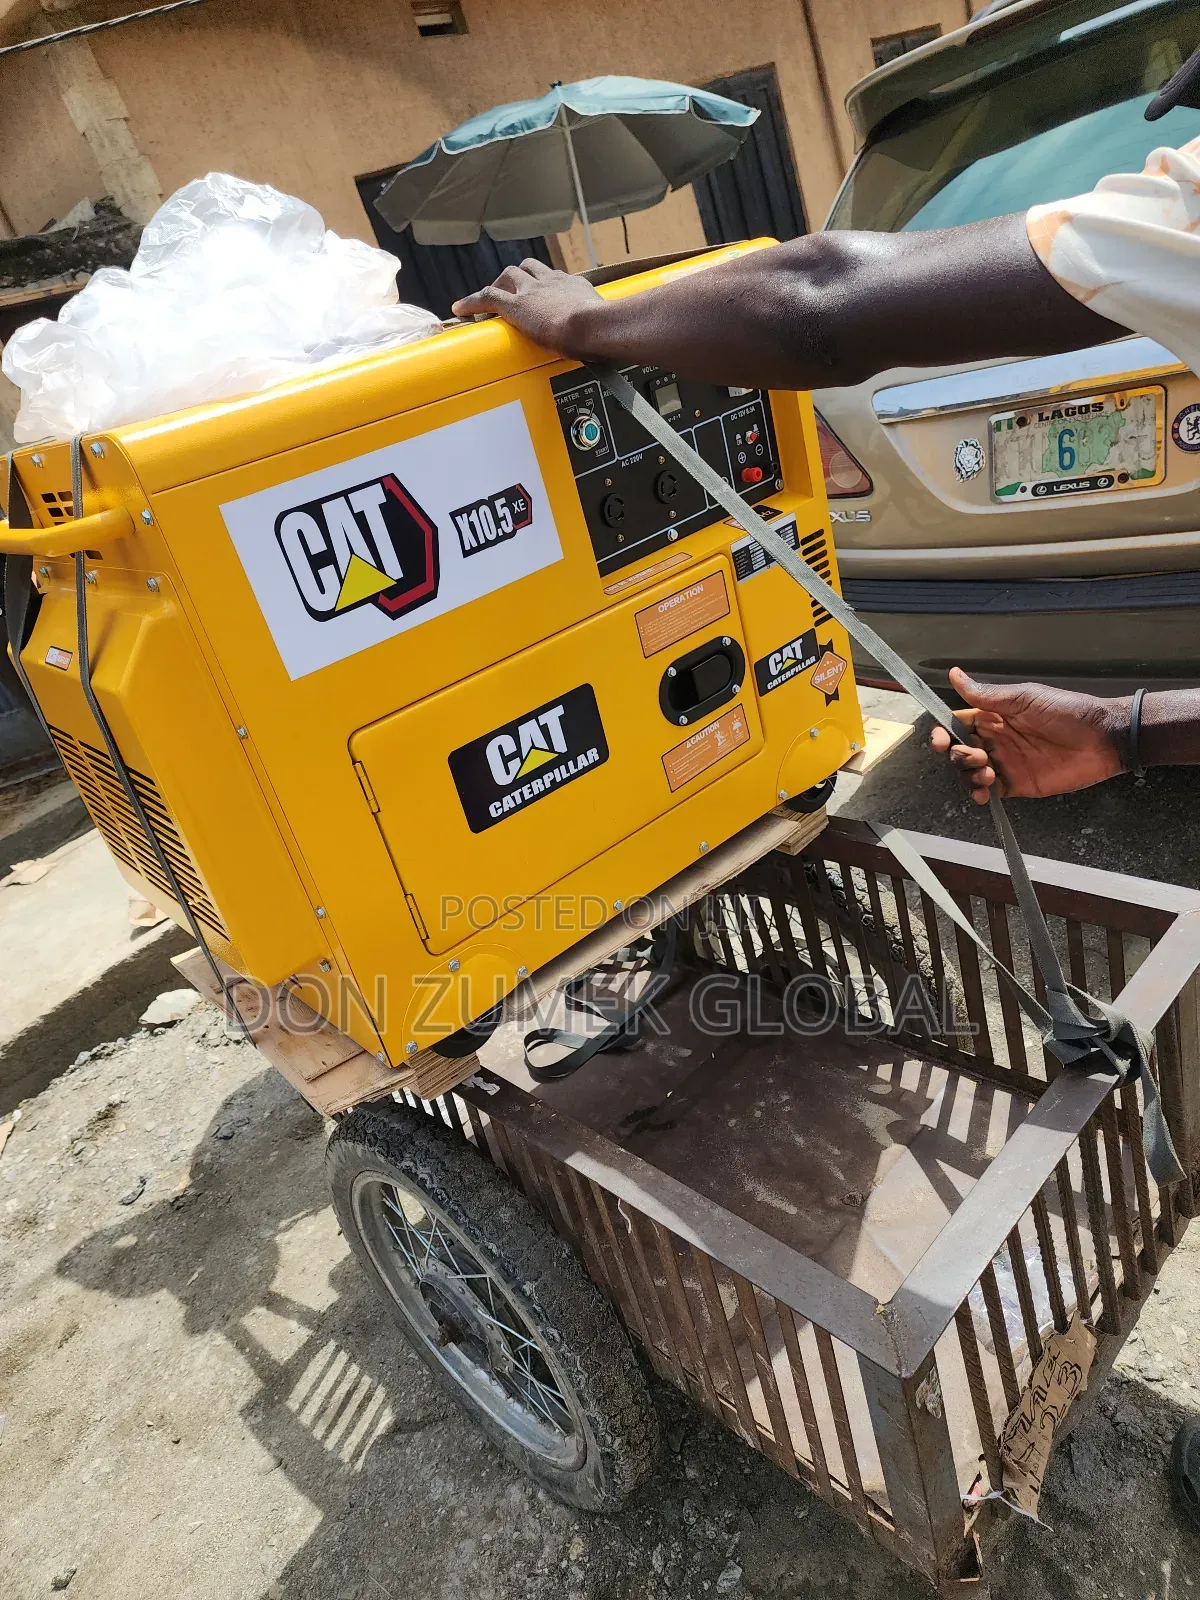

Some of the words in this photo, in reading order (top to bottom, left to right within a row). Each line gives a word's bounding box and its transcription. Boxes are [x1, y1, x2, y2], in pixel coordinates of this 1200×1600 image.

[1038, 402, 1105, 422] LAGOS
[621, 459, 630, 468] AC
[630, 453, 644, 464] 220V
[1058, 429, 1076, 471] 6
[1053, 481, 1091, 492] LEXUS
[456, 497, 513, 551] X10.5
[512, 498, 527, 514] XE
[280, 482, 404, 612] CAT
[658, 584, 704, 613] OPERATION
[767, 655, 817, 690] CATERPILLAR
[768, 638, 804, 676] CAT
[814, 663, 844, 685] SILENT
[485, 704, 568, 786] CAT
[690, 721, 720, 745] CAUTION
[488, 747, 600, 818] CATERPILLAR
